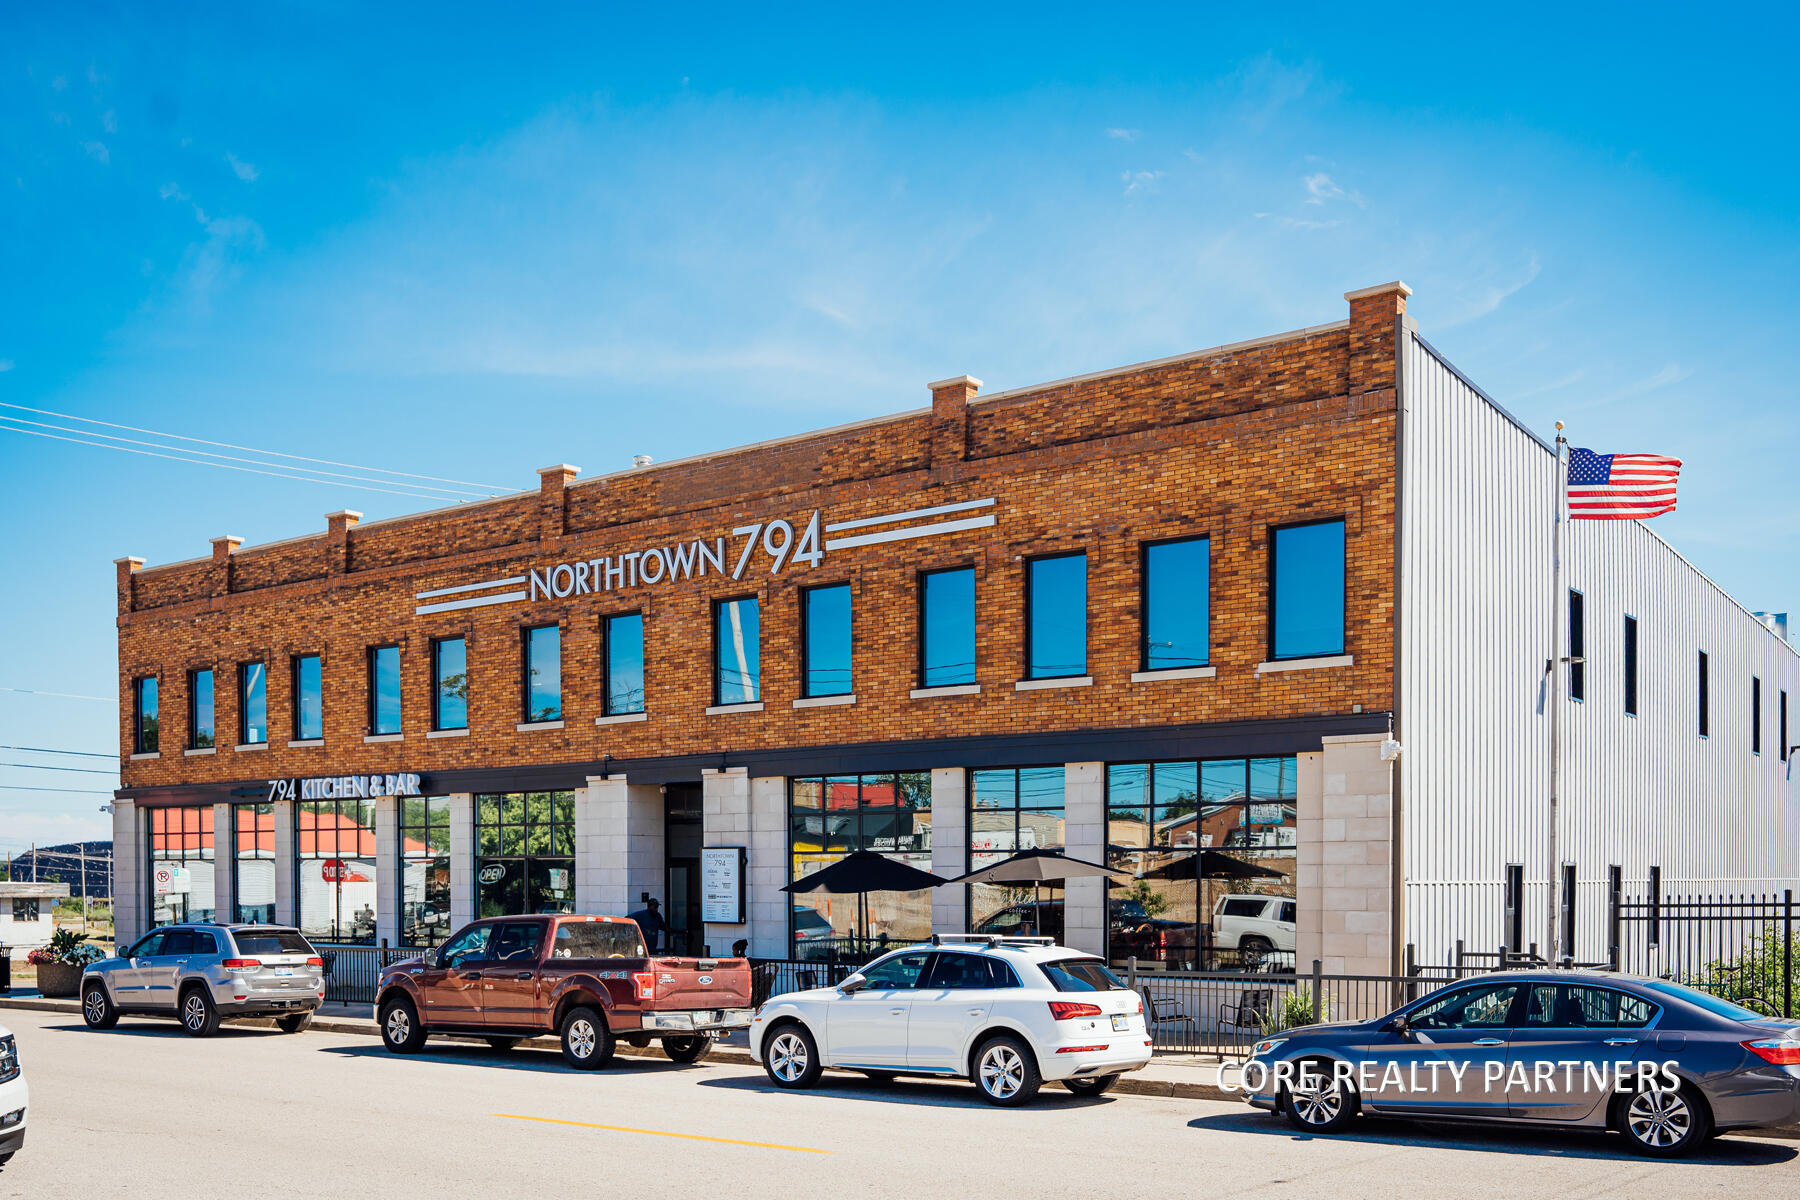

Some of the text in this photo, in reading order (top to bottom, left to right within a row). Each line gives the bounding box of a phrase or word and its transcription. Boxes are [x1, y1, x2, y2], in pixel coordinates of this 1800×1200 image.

[530, 508, 826, 602] NORTHTOWN 794
[267, 773, 422, 802] 794 KITCHEN & BAR
[714, 859, 726, 867] 794
[480, 868, 503, 881] OPEN
